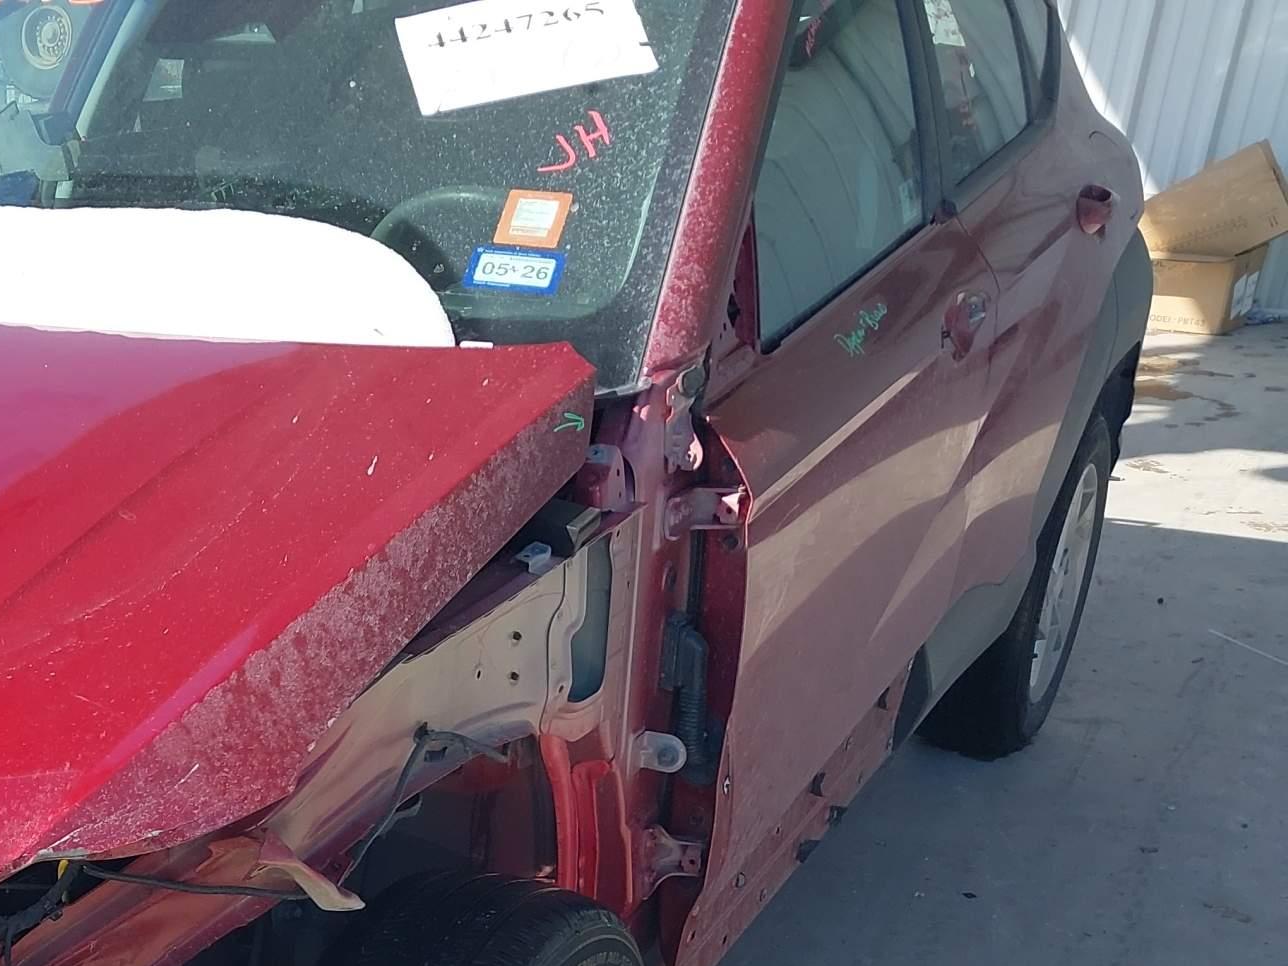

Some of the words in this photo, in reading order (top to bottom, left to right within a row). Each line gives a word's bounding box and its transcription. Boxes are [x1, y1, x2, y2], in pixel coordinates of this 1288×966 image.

[537, 110, 610, 172] JH
[482, 261, 510, 277] 05
[520, 264, 550, 280] 26
